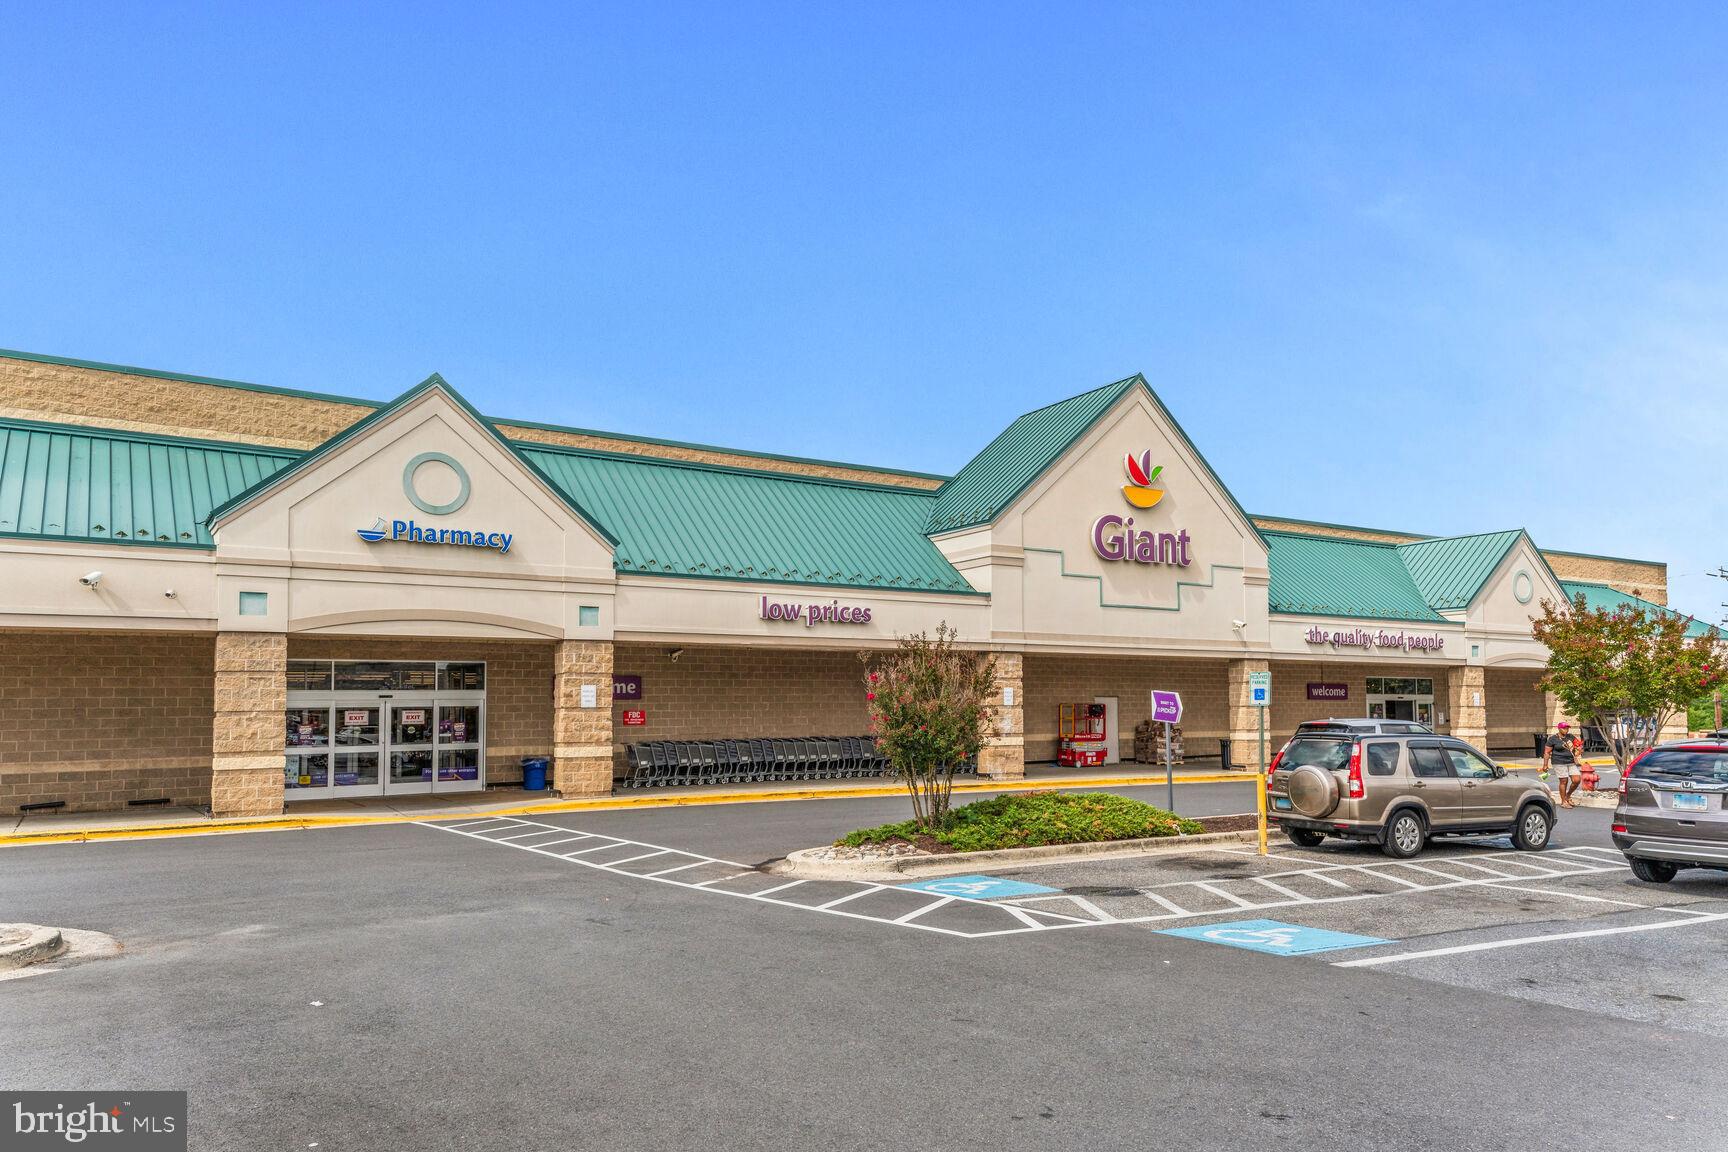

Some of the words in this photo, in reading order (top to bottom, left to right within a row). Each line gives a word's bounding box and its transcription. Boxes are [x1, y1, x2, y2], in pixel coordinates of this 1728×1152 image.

[391, 520, 514, 554] Pharmacy
[1092, 514, 1192, 567] Giant
[761, 594, 802, 620] low
[805, 599, 872, 627] prices
[1307, 625, 1329, 642] the
[1333, 628, 1374, 649] quality
[1376, 630, 1404, 646] food
[1407, 632, 1444, 653] people
[1311, 685, 1347, 697] welcome
[628, 711, 641, 719] FDC
